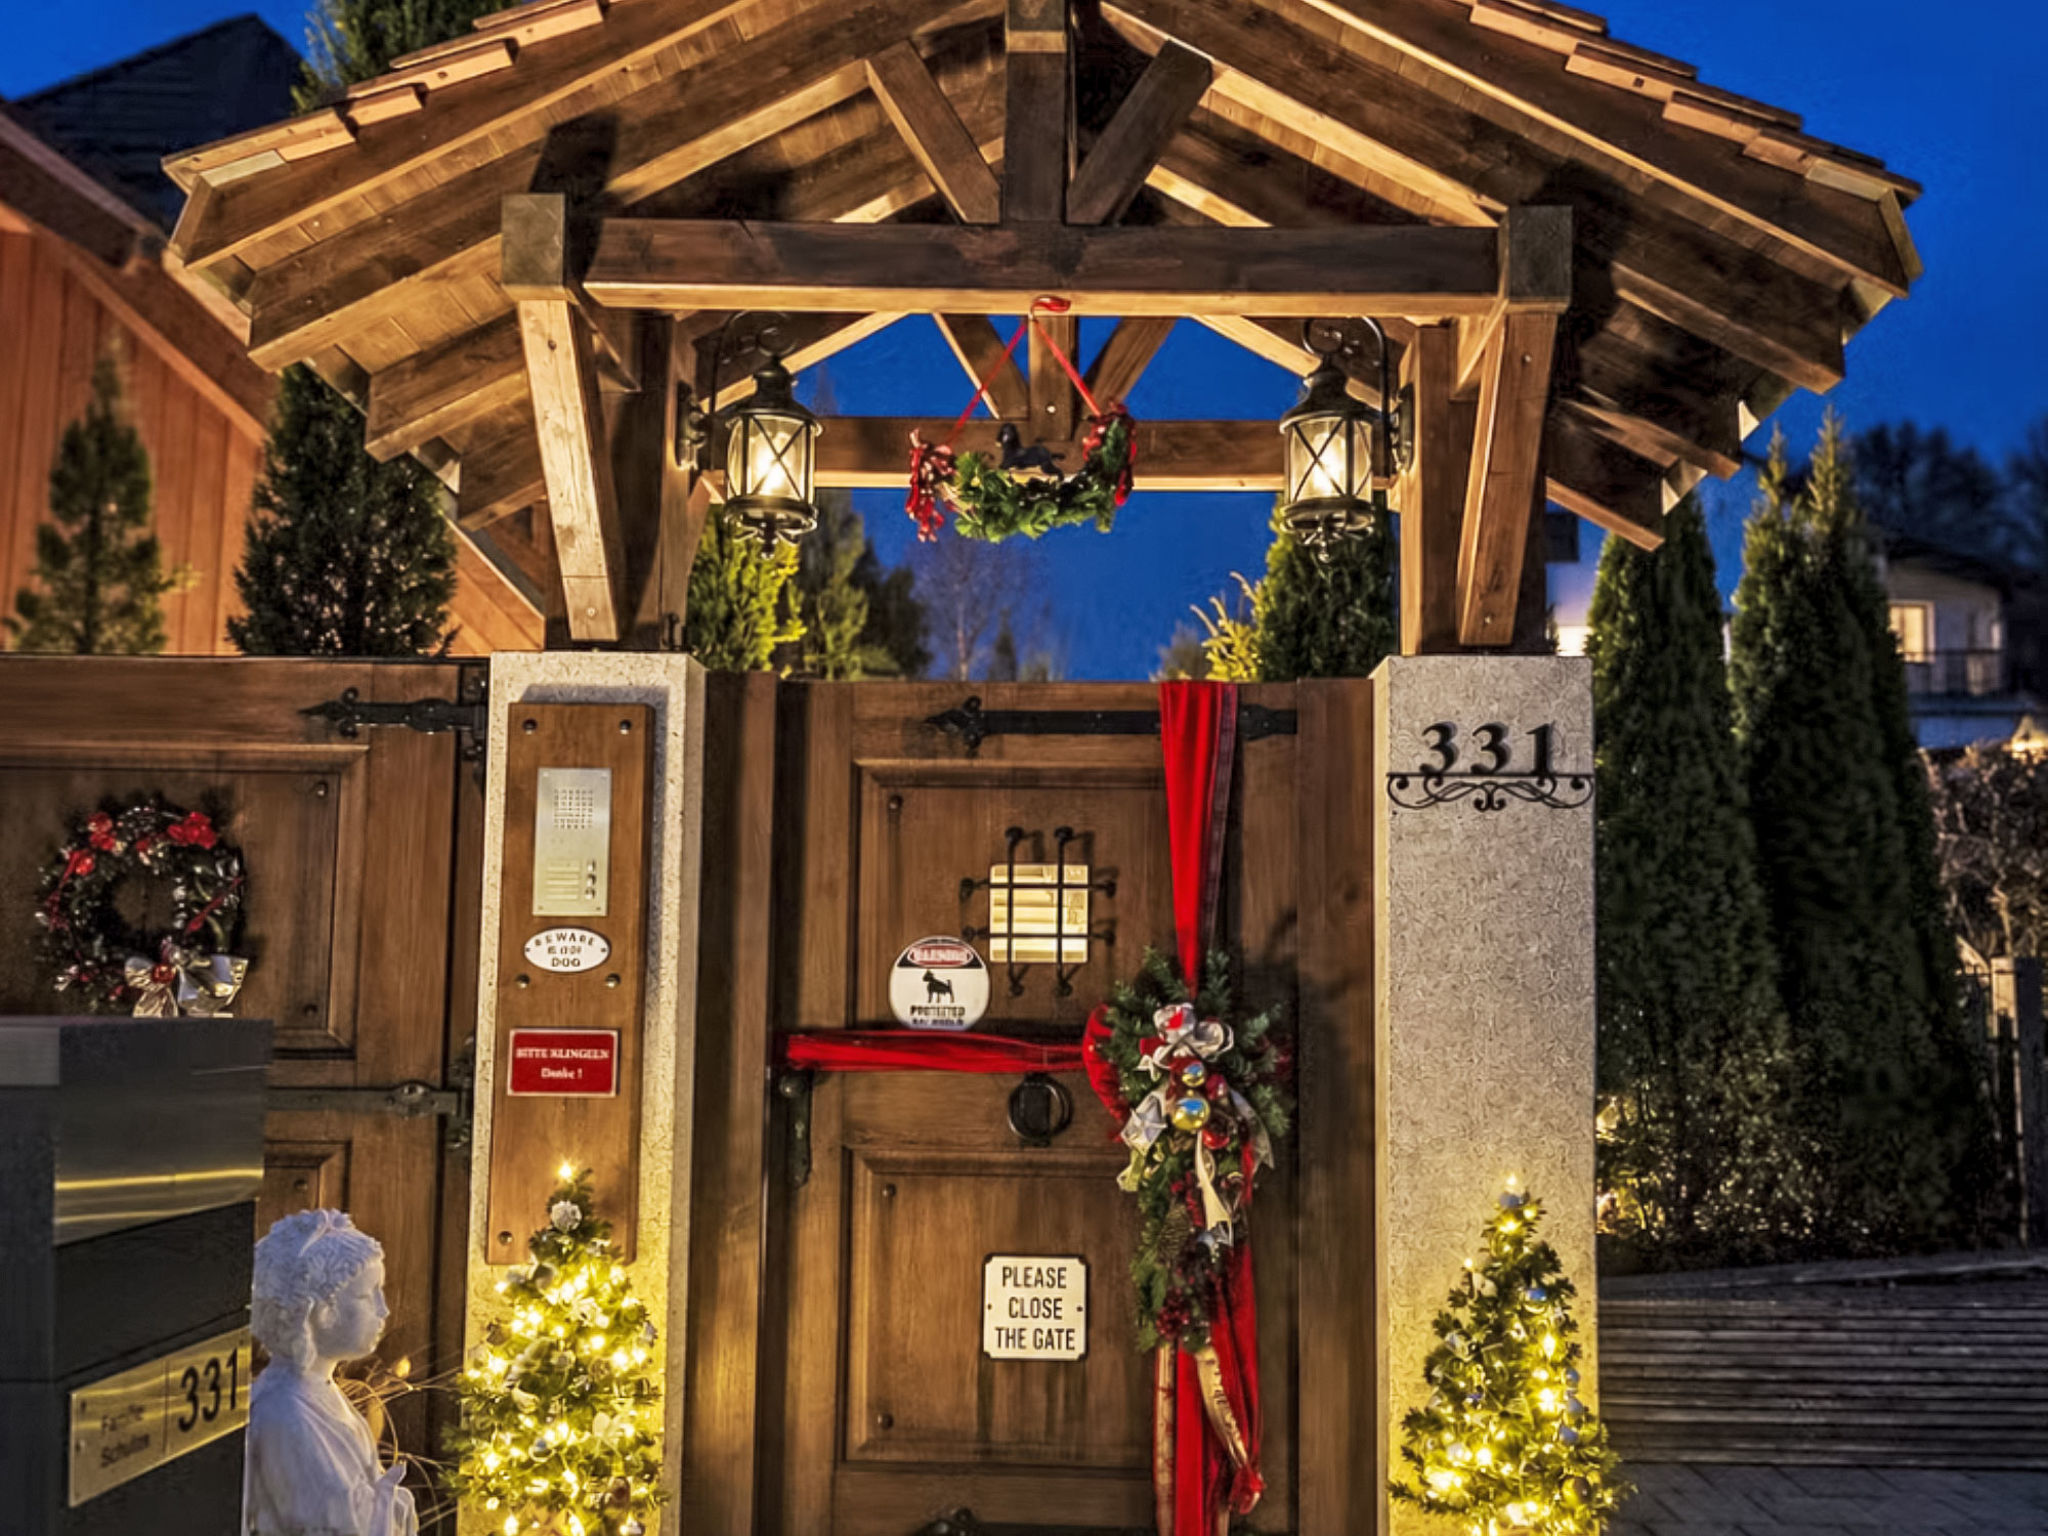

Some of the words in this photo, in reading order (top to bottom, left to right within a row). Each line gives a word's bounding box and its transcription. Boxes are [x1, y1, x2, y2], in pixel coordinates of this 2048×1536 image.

[1419, 721, 1555, 777] 331
[1002, 1265, 1067, 1289] PLEASE
[1008, 1296, 1063, 1320] CLOSE
[995, 1326, 1027, 1350] THE
[1033, 1327, 1075, 1351] GATE
[178, 1348, 238, 1433] 331
